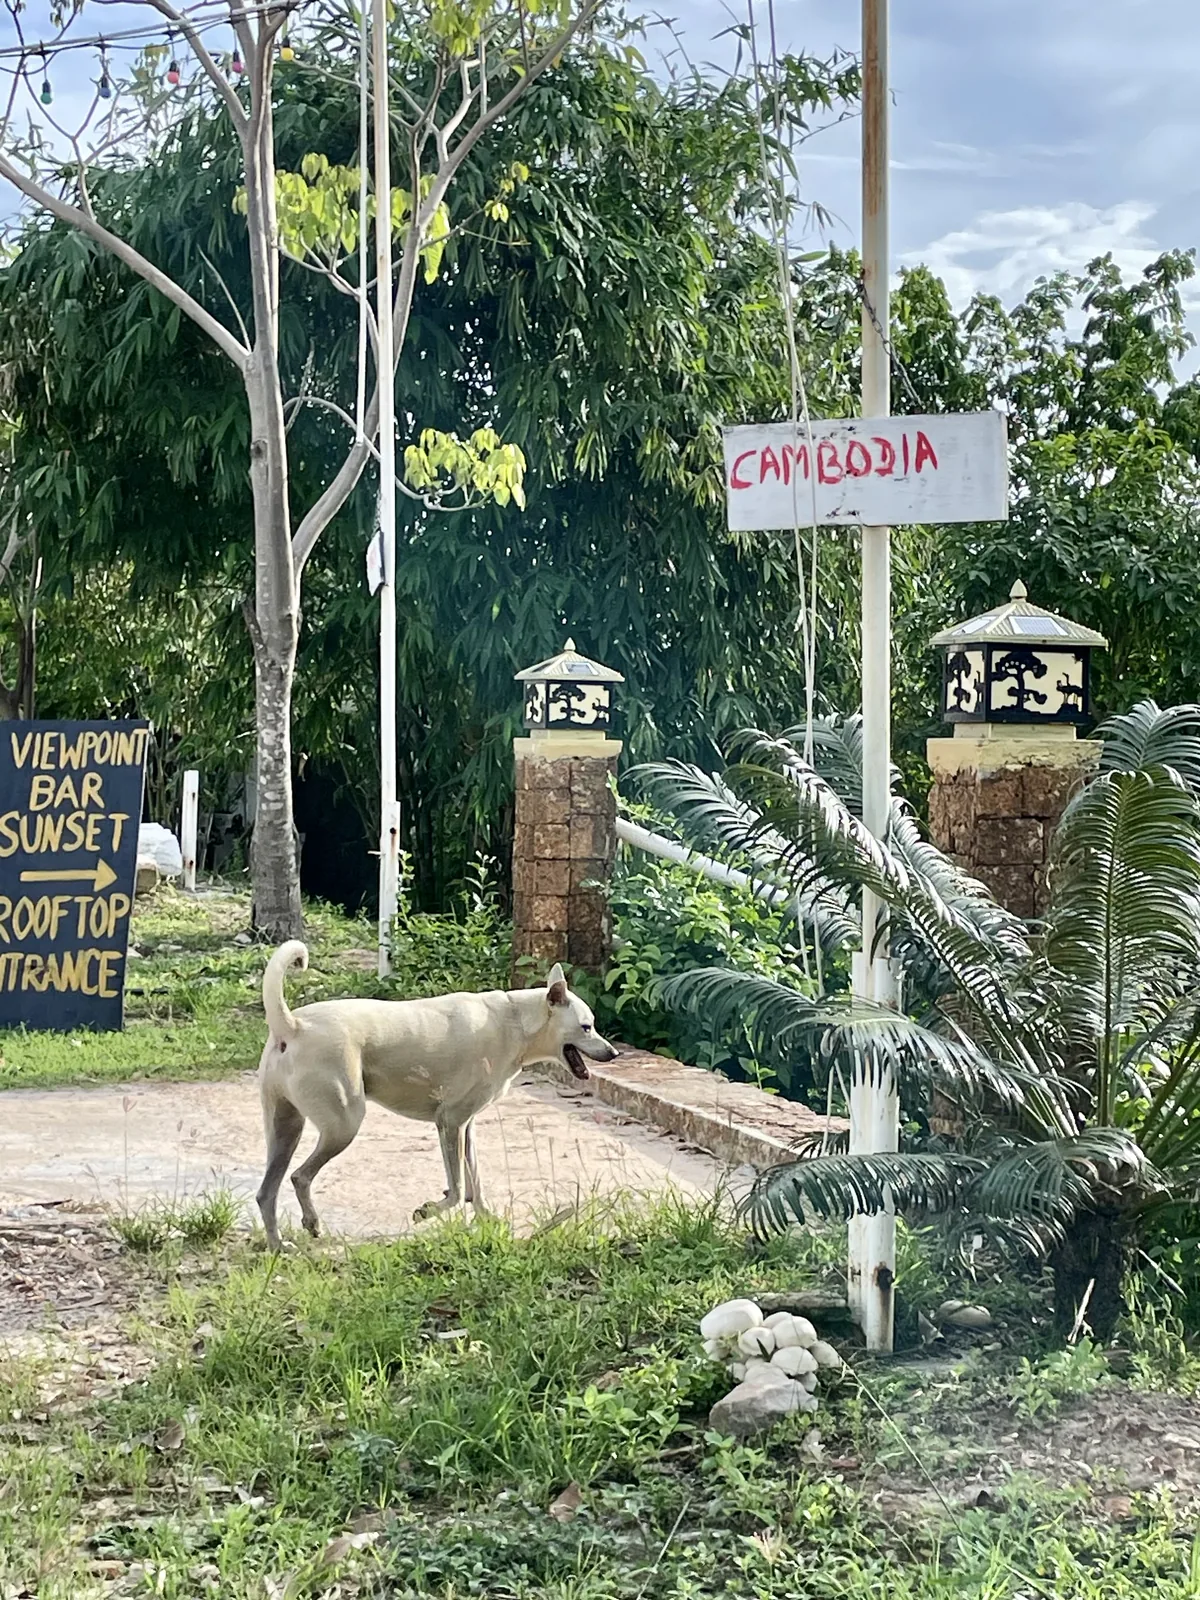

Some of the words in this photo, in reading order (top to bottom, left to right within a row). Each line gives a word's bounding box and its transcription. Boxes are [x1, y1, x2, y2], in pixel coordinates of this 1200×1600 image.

[730, 431, 938, 490] CAMBODIA
[11, 728, 148, 770] VIEWPOINT
[29, 772, 105, 812] BAR
[0, 810, 130, 858] SUNSET
